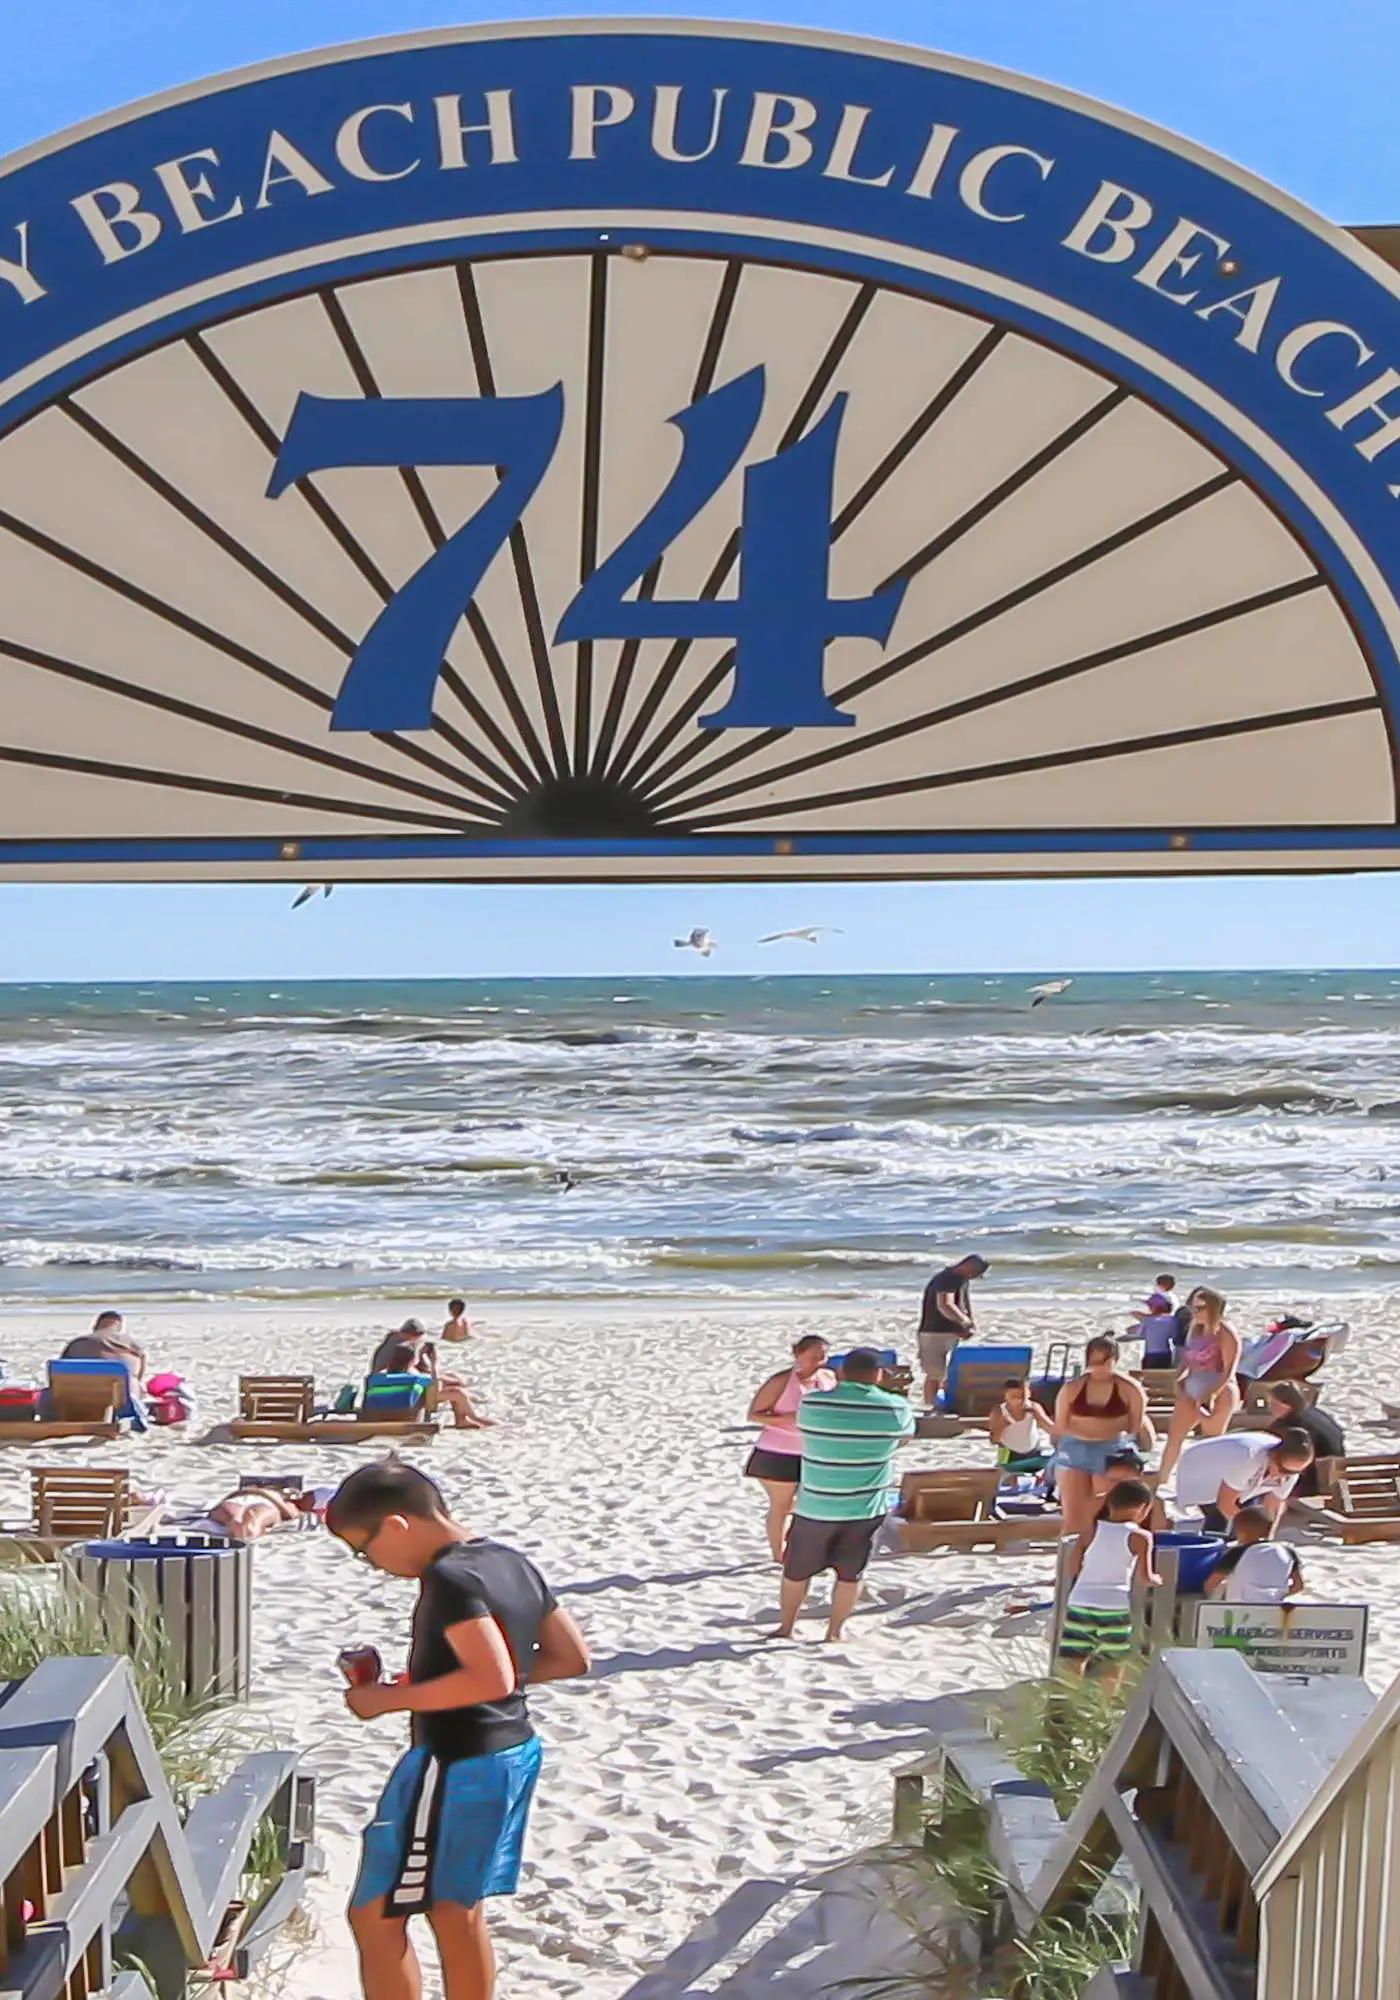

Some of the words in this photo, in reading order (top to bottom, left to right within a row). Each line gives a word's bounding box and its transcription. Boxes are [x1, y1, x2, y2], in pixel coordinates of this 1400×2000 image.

[69, 88, 519, 266] BEACH
[567, 84, 1056, 223] PUBLIC
[1060, 179, 1400, 463] BEACH
[264, 362, 912, 732] 74
